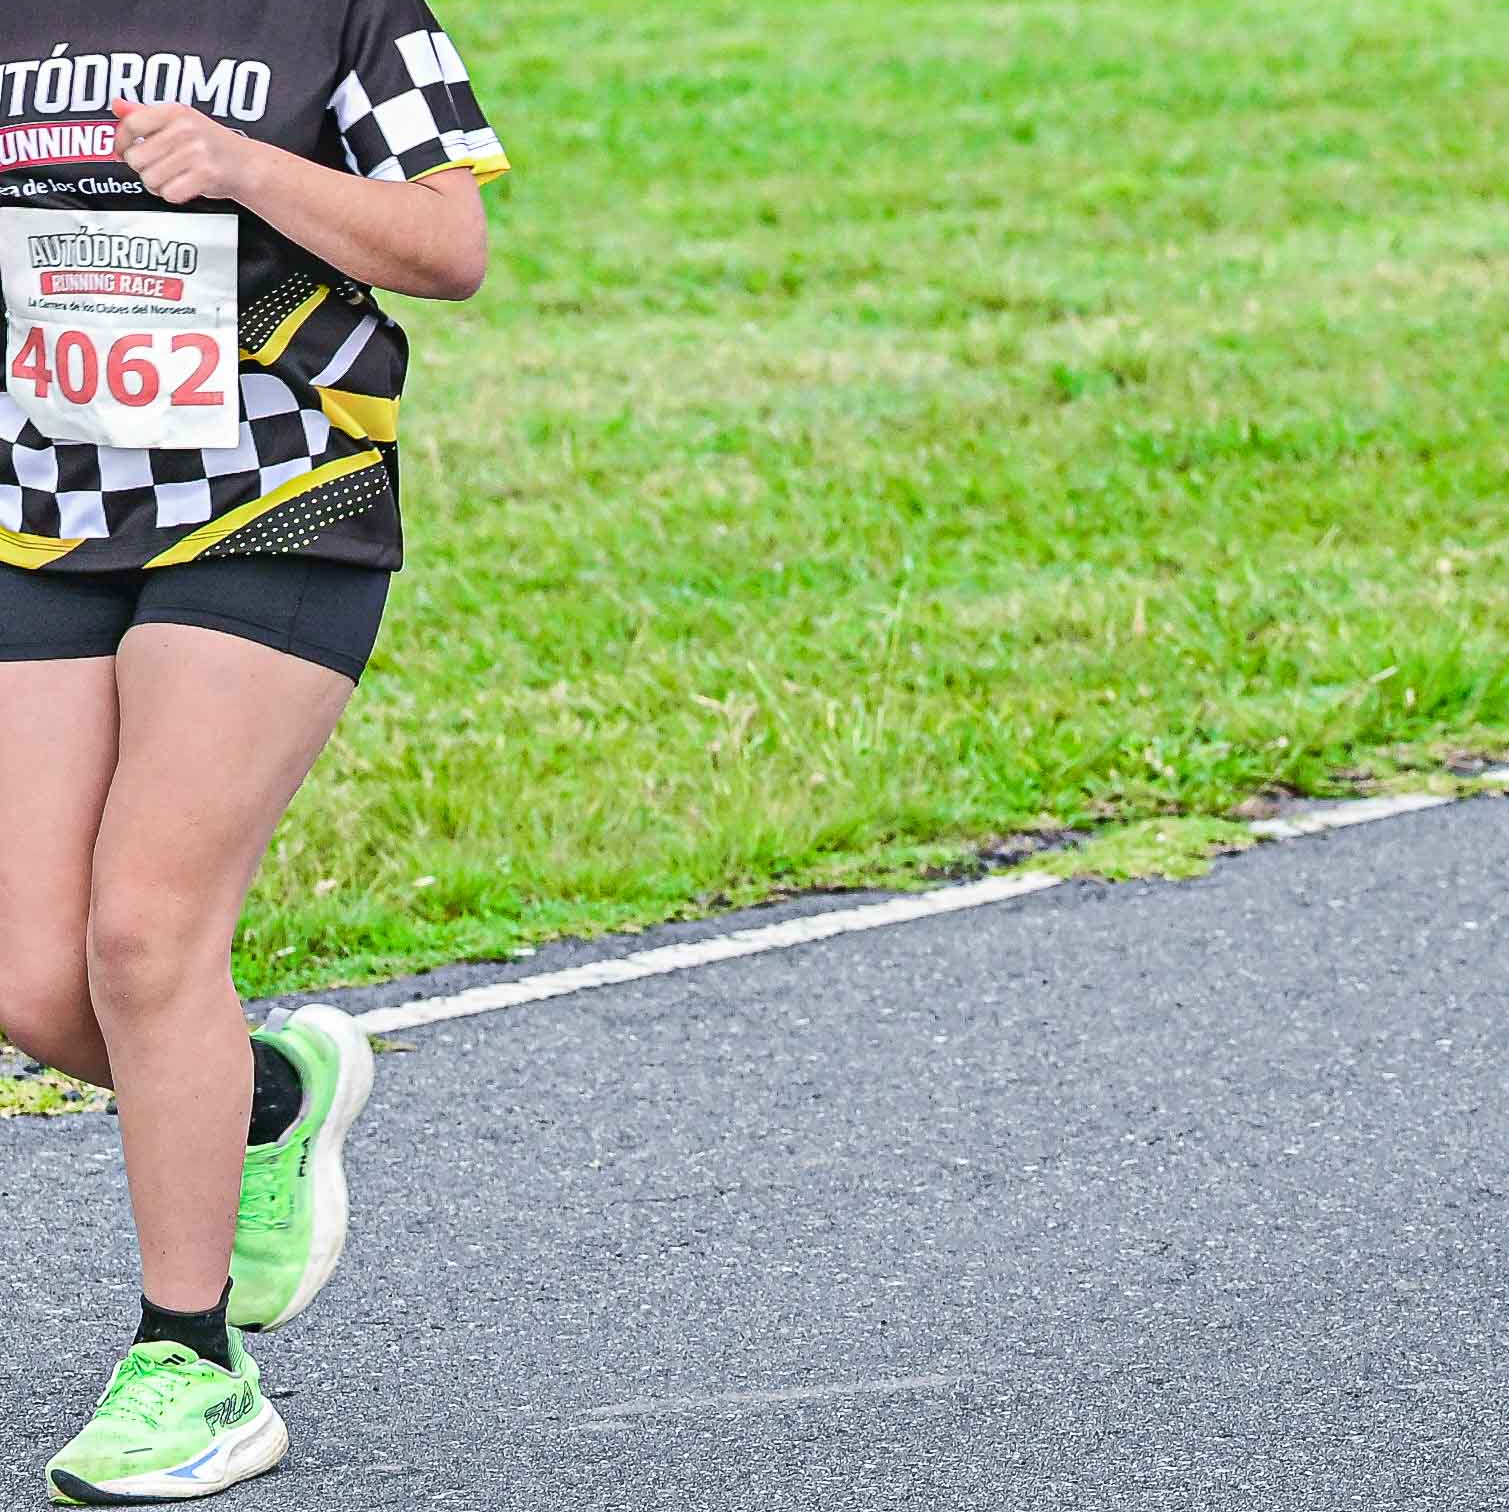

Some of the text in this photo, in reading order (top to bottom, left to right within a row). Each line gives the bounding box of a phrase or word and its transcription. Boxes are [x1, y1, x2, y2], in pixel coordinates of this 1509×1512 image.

[0, 43, 272, 122] TÓDROMO
[0, 125, 115, 166] UNNING
[22, 178, 48, 196] de
[48, 178, 76, 193] los
[78, 177, 143, 194] Clubes
[28, 226, 198, 275] AUTÓDROMO
[119, 277, 165, 297] RACE
[11, 326, 225, 408] 4062
[204, 1380, 254, 1437] FILA
